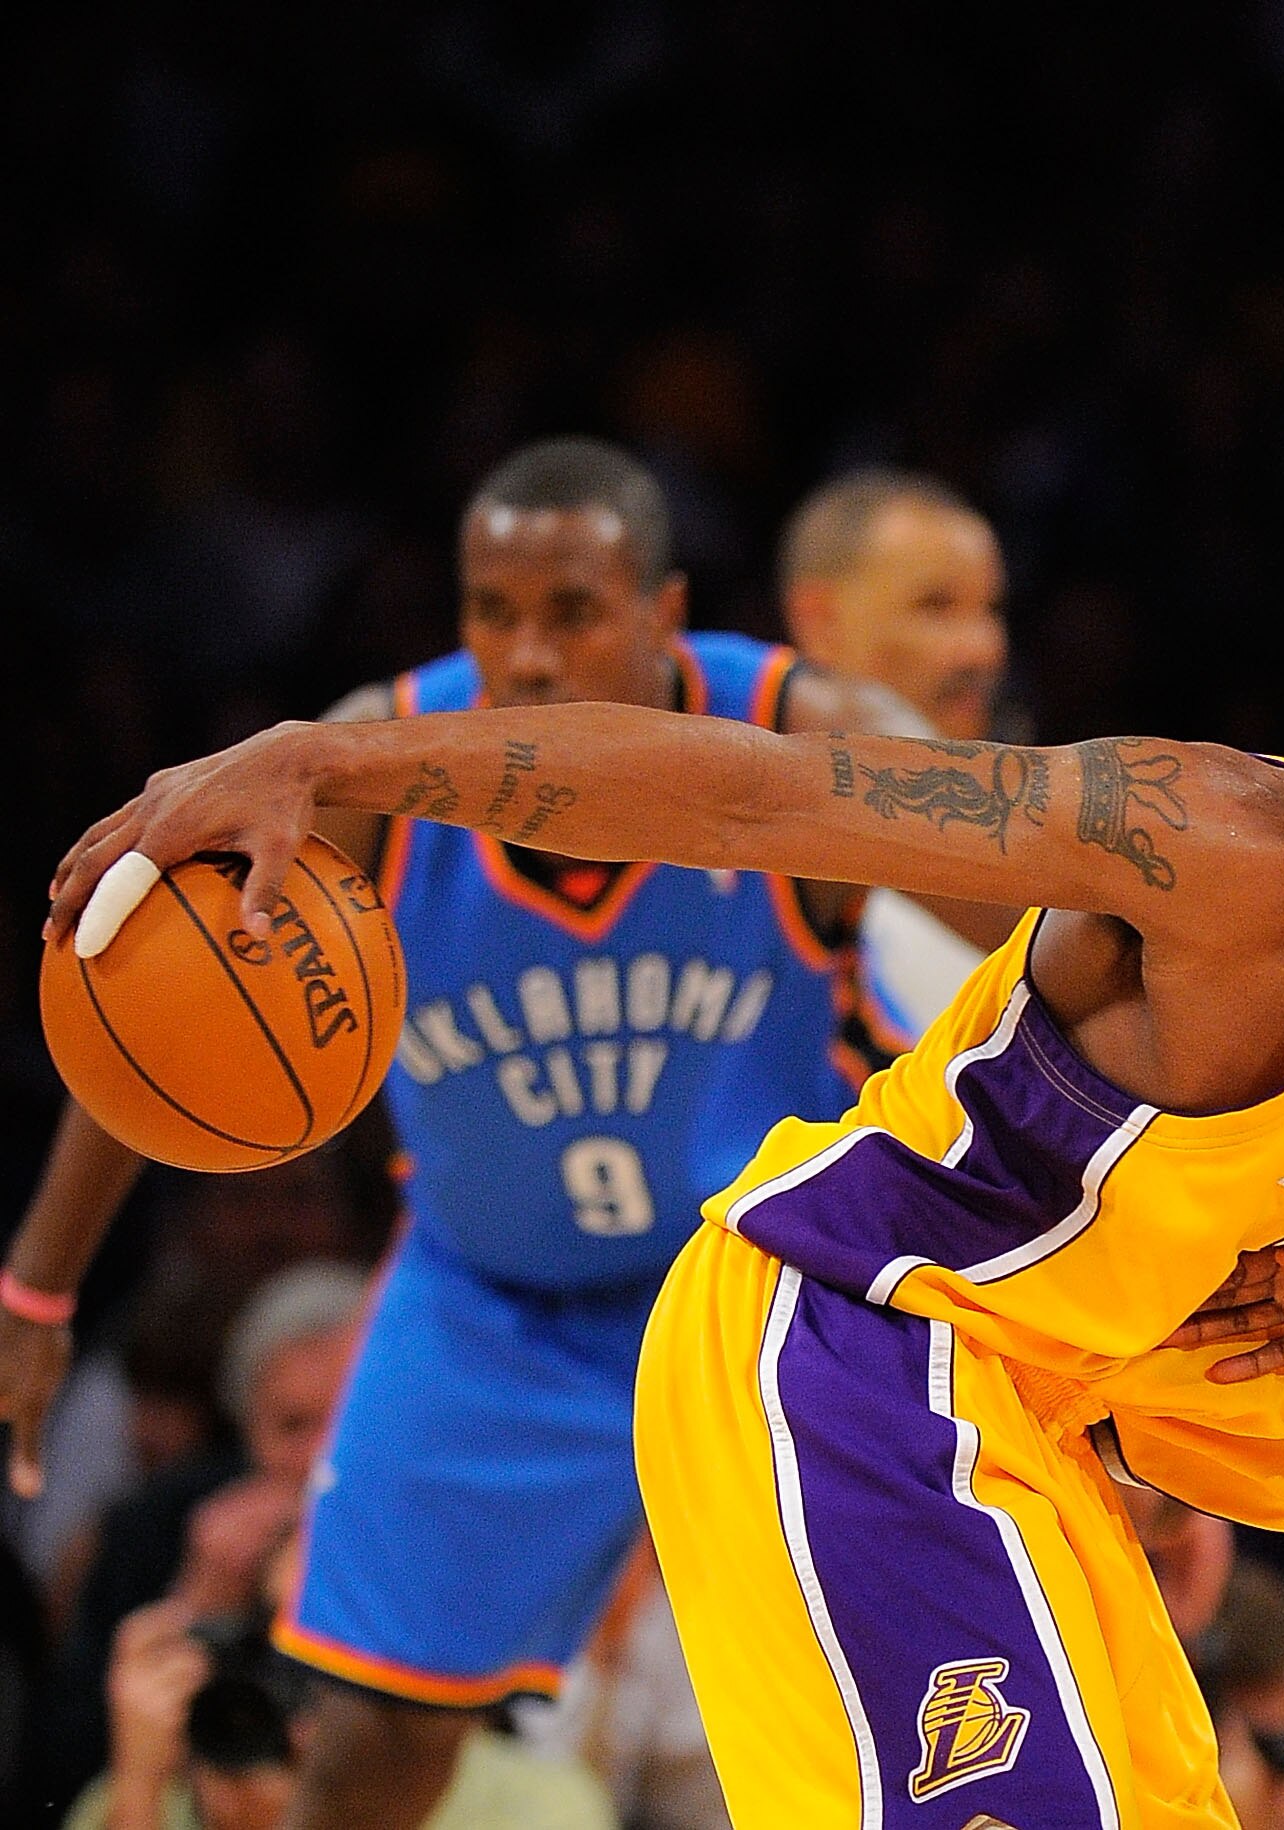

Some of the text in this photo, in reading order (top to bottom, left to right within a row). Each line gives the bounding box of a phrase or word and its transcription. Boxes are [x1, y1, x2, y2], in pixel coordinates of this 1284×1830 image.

[266, 893, 359, 1050] SPALL
[498, 1037, 669, 1128] CITY
[561, 1135, 656, 1237] 9
